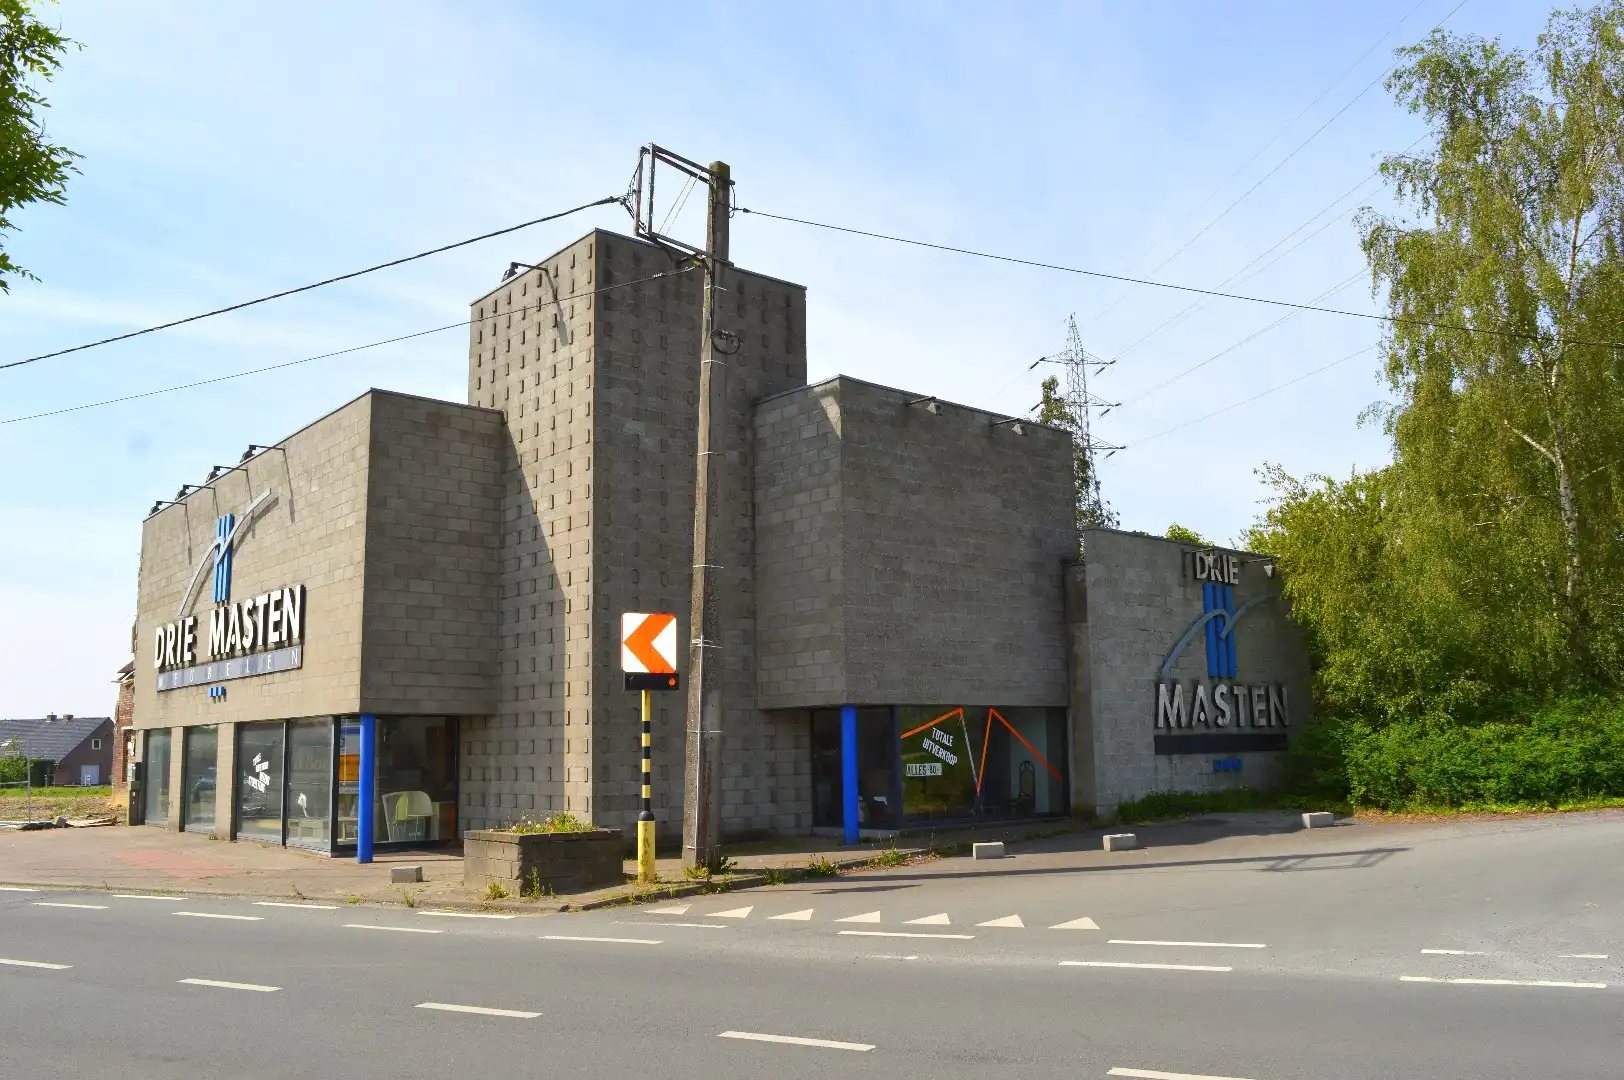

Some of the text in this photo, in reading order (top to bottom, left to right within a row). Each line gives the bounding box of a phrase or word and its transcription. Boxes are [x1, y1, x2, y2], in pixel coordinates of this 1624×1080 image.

[1195, 551, 1239, 585] DRIE
[153, 584, 304, 669] DRIE MASTEN
[1157, 683, 1290, 728] MASTEN
[922, 737, 958, 766] UITVERKOOP
[932, 727, 953, 747] TOTALE
